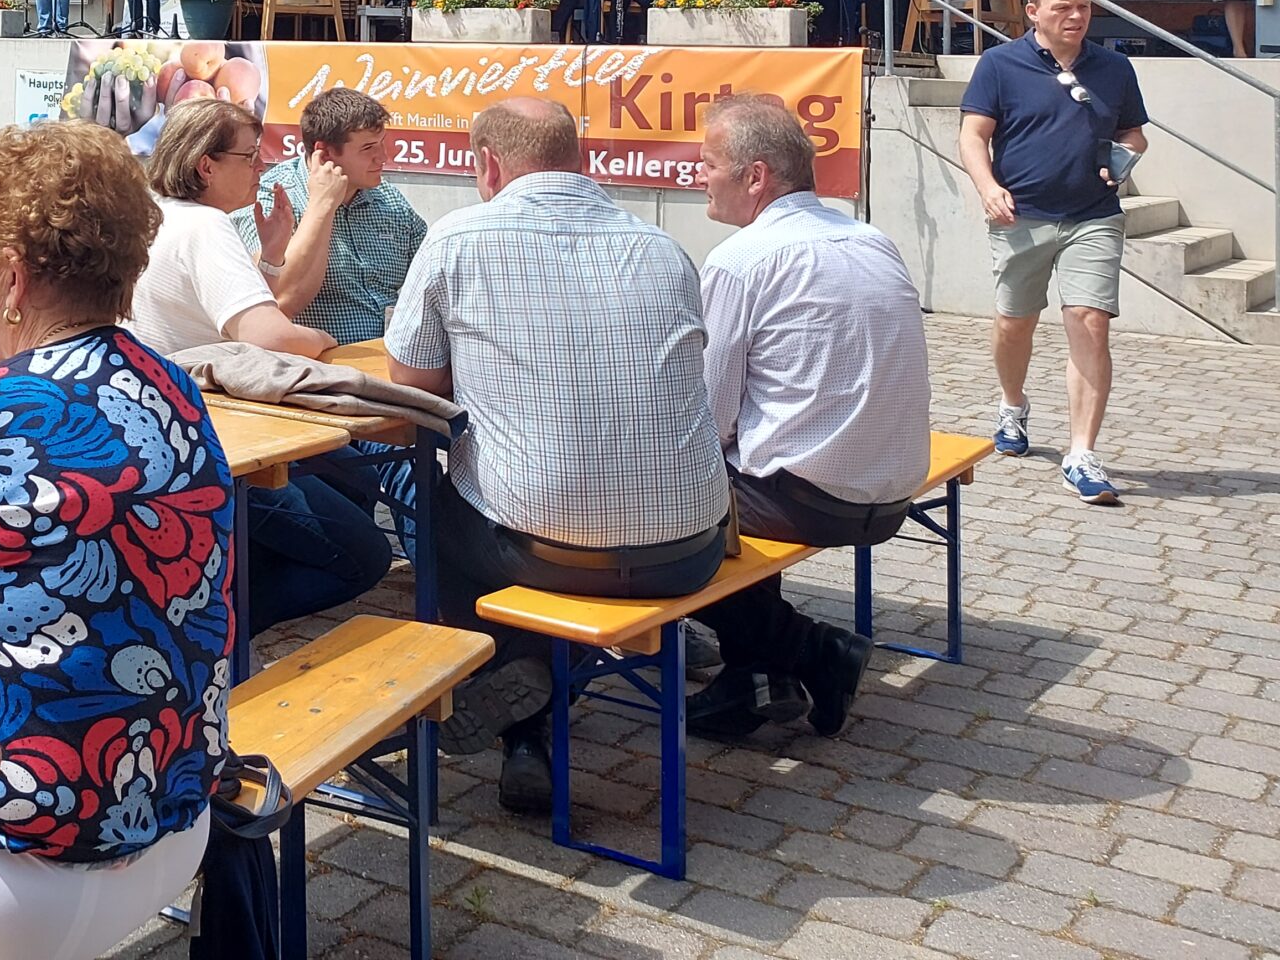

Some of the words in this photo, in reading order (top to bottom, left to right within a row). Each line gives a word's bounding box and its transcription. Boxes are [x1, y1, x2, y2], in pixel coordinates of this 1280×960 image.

[28, 78, 64, 91] Haupts
[407, 114, 453, 129] Marille
[456, 114, 469, 129] in
[609, 72, 843, 153] Kirg
[393, 139, 429, 165] 25.
[436, 142, 477, 168] Jun
